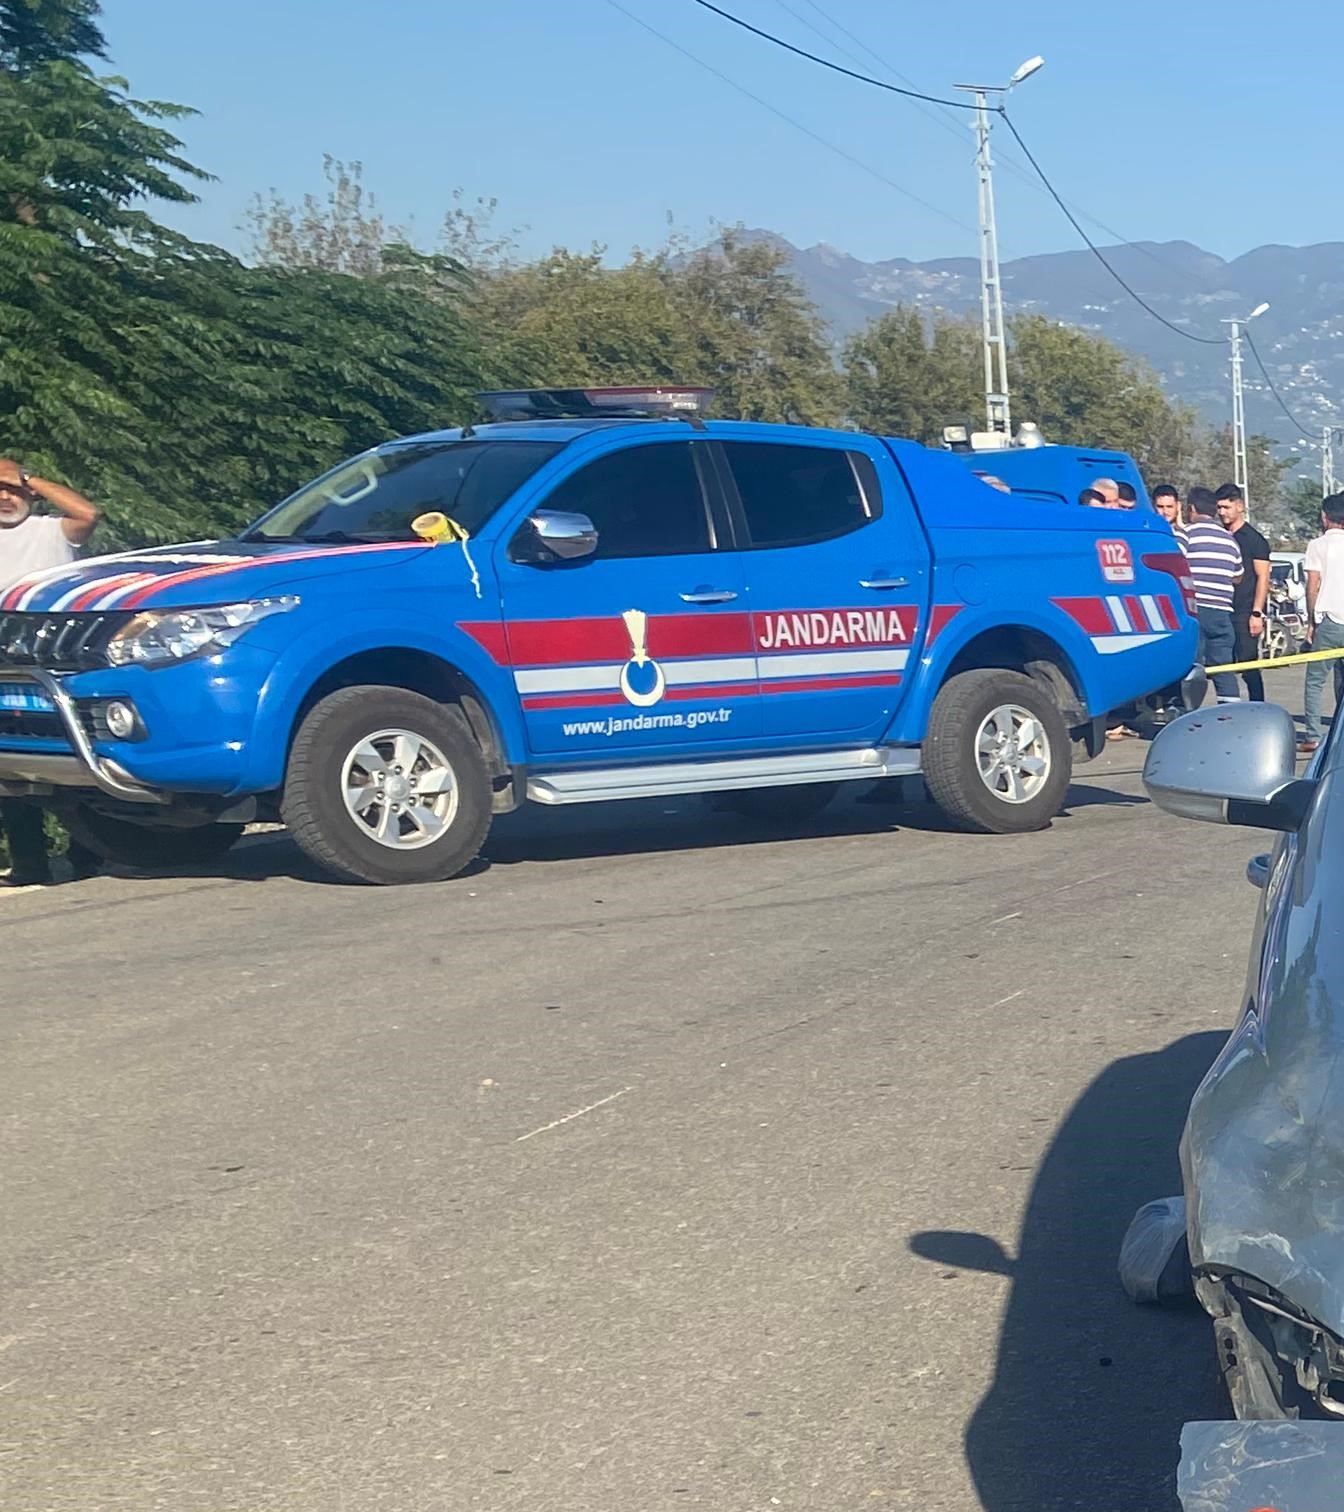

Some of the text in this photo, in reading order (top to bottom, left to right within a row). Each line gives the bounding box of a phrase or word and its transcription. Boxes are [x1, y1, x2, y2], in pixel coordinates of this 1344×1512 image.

[1101, 543, 1128, 565] 112
[759, 610, 907, 649] JANDARMA
[562, 707, 732, 736] www.jandarma.gov.tr
